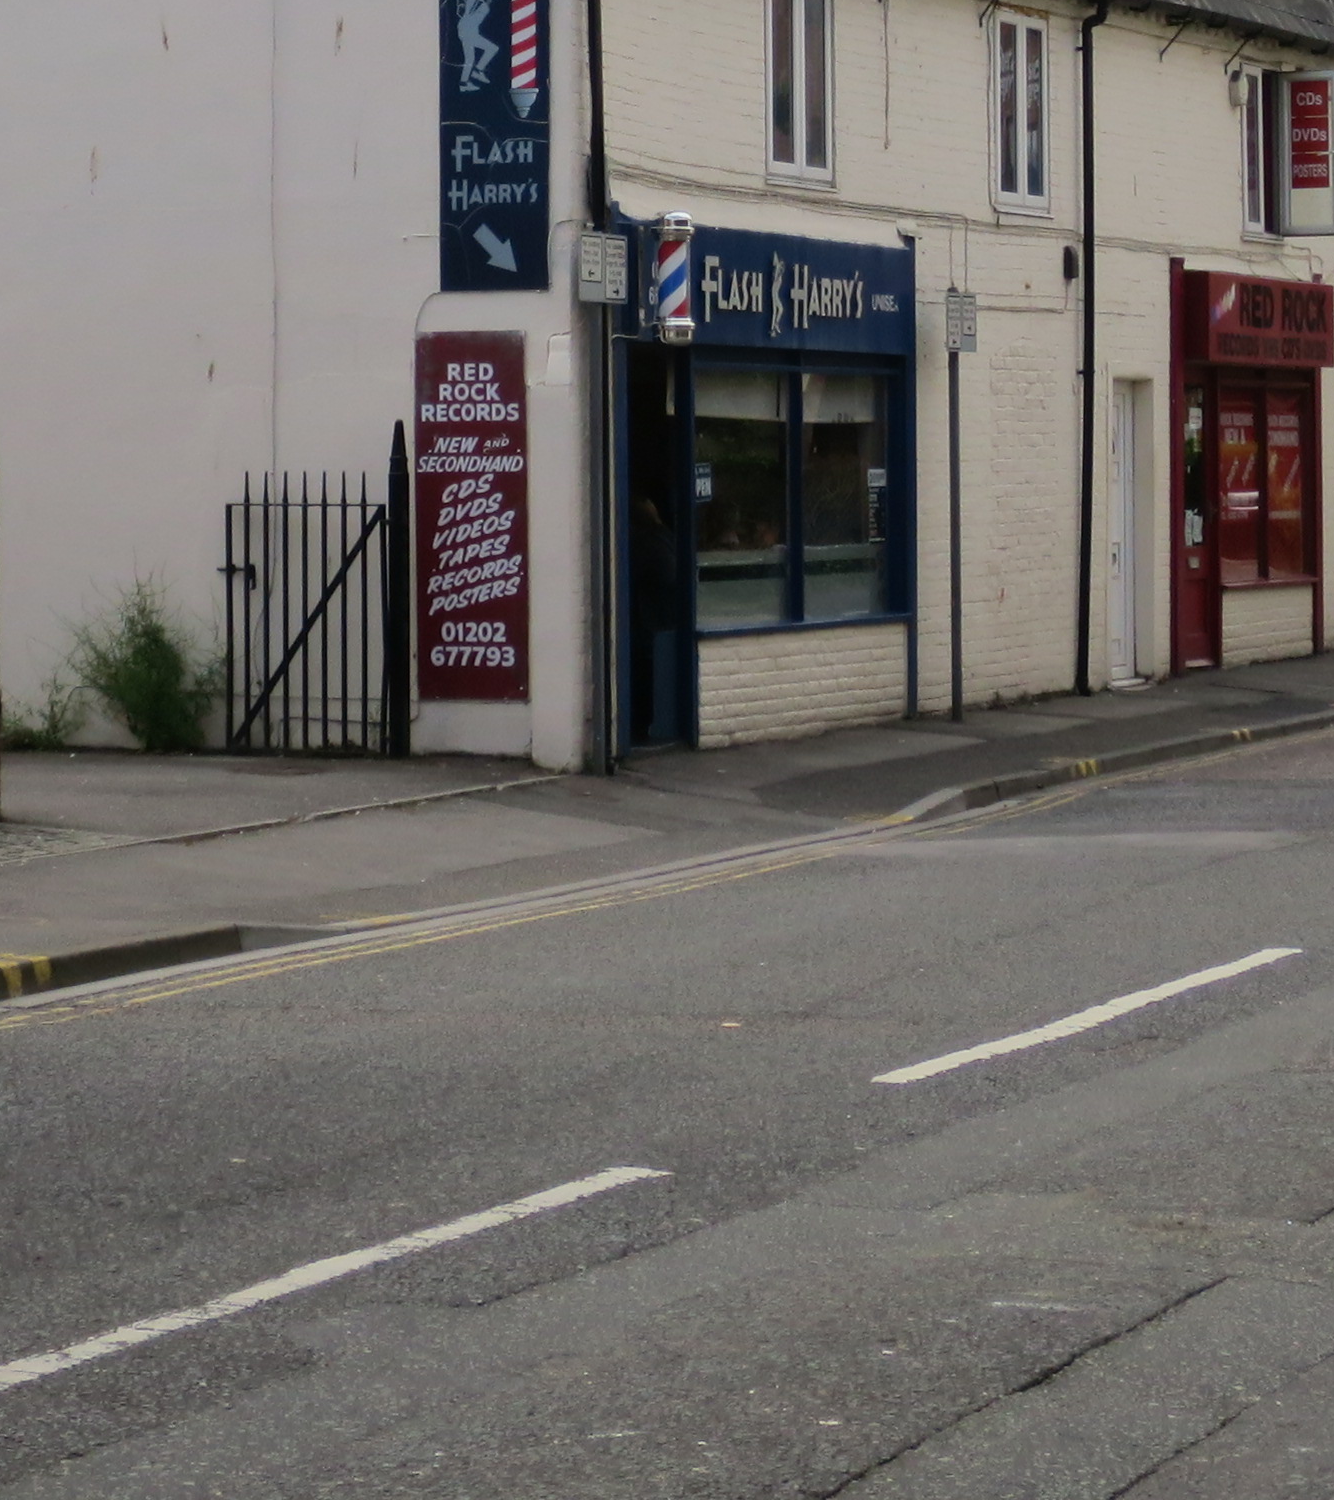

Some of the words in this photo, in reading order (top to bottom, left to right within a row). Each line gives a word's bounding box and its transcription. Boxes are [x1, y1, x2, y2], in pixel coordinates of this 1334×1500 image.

[1296, 92, 1323, 106] CDs
[1292, 127, 1327, 142] DVDs
[451, 135, 533, 172] FLASH
[1293, 163, 1328, 178] POSTERS
[447, 178, 538, 211] HARRY'S
[701, 255, 763, 322] FLASH
[790, 263, 864, 329] HARRY'S
[1239, 282, 1274, 329] RED
[1281, 288, 1327, 334] ROCK
[446, 363, 495, 381] RED
[438, 382, 501, 401] ROCK
[421, 403, 520, 422] RECORDS
[433, 436, 479, 453] NEW
[483, 438, 510, 449] AND
[417, 455, 524, 473] SECONDHAND
[441, 473, 494, 503] CDS
[437, 493, 503, 527] DVDS
[432, 510, 516, 550] VIDEOS
[438, 534, 511, 570] TAPES
[427, 554, 523, 594] RECORDS
[428, 576, 521, 616] POSTERS
[441, 621, 507, 642] 01202
[430, 645, 516, 668] 677793
